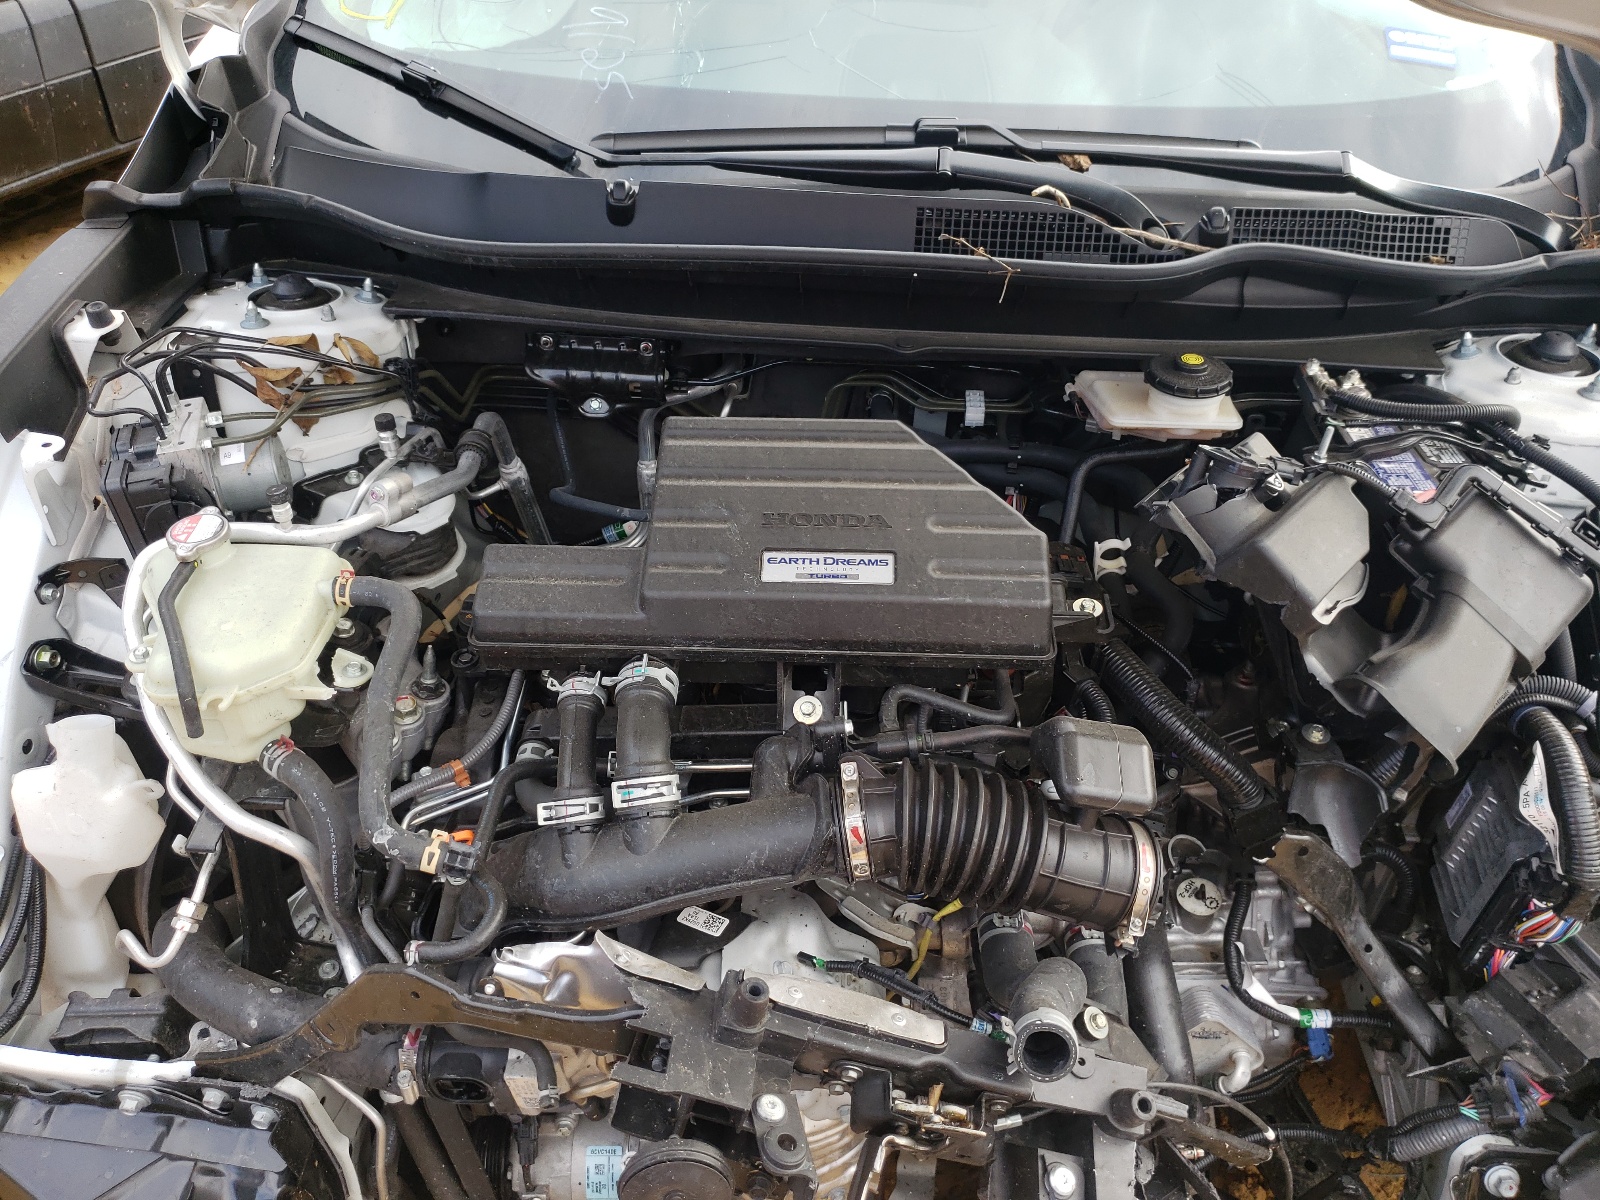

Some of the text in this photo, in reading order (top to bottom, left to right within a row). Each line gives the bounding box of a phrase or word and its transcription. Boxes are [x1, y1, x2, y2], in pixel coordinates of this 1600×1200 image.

[761, 512, 893, 529] HONDA
[767, 556, 889, 567] EARTH DREAMS
[1178, 879, 1196, 899] HCF-2
